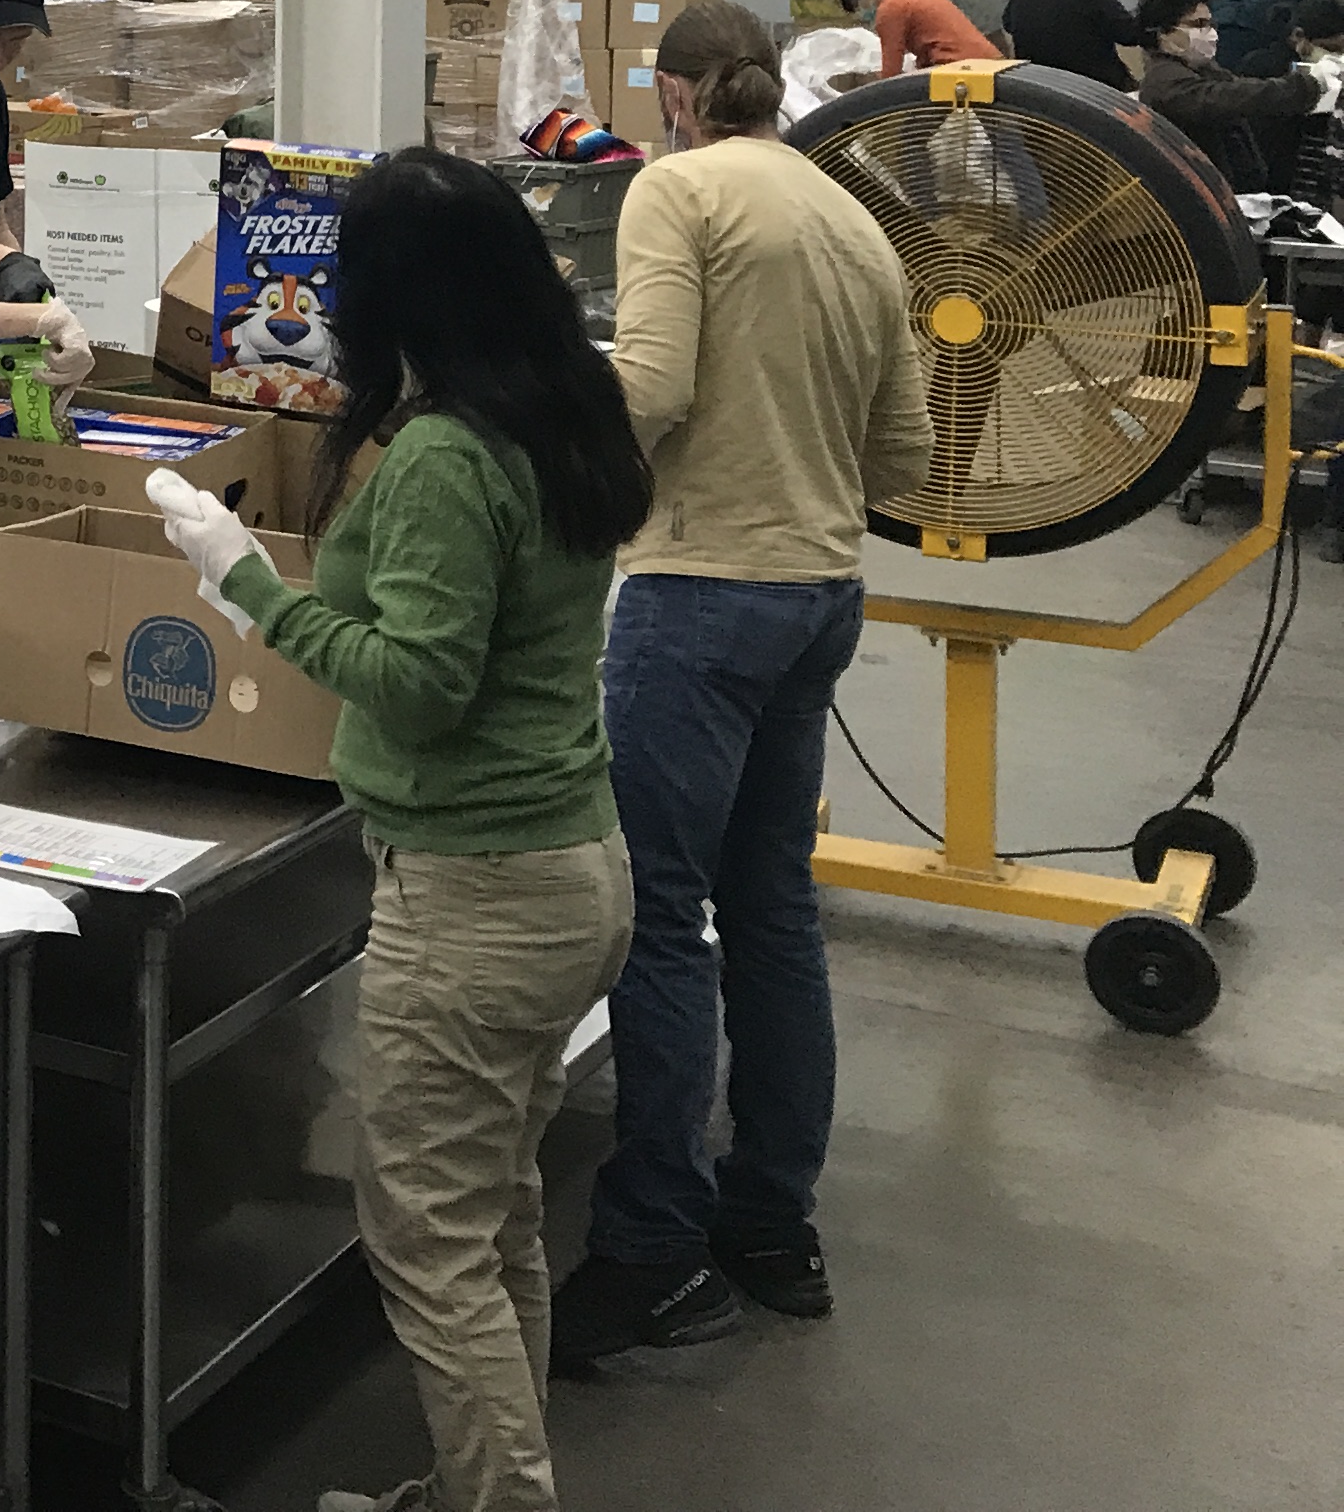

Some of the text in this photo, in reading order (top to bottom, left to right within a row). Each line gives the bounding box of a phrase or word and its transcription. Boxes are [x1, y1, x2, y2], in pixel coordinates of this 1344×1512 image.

[272, 155, 363, 175] FAMILY SIZ
[67, 232, 98, 243] NEEDED
[99, 234, 125, 244] ITEMS
[245, 235, 339, 255] FLAKES
[26, 378, 45, 443] STACHIOS
[7, 454, 45, 467] PACKER
[127, 672, 210, 711] Chiquita
